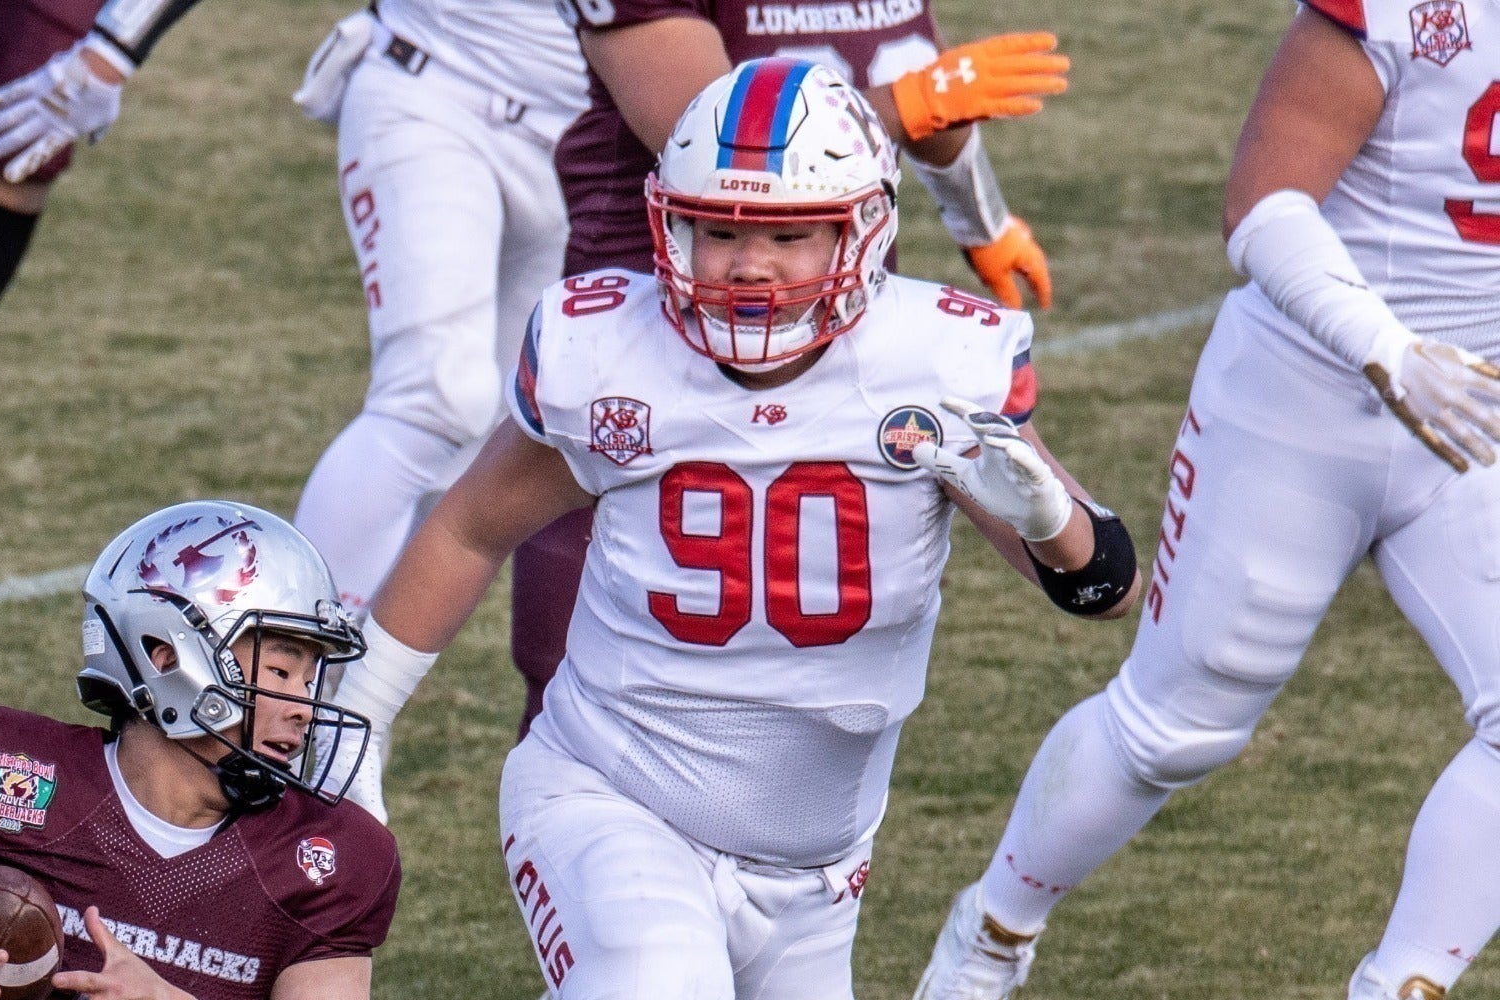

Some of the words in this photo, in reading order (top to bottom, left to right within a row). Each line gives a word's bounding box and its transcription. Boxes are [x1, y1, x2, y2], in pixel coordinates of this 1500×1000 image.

[720, 179, 771, 193] LOTUS
[562, 274, 631, 318] 90
[647, 461, 872, 648] 90
[56, 903, 261, 984] MERJACKS
